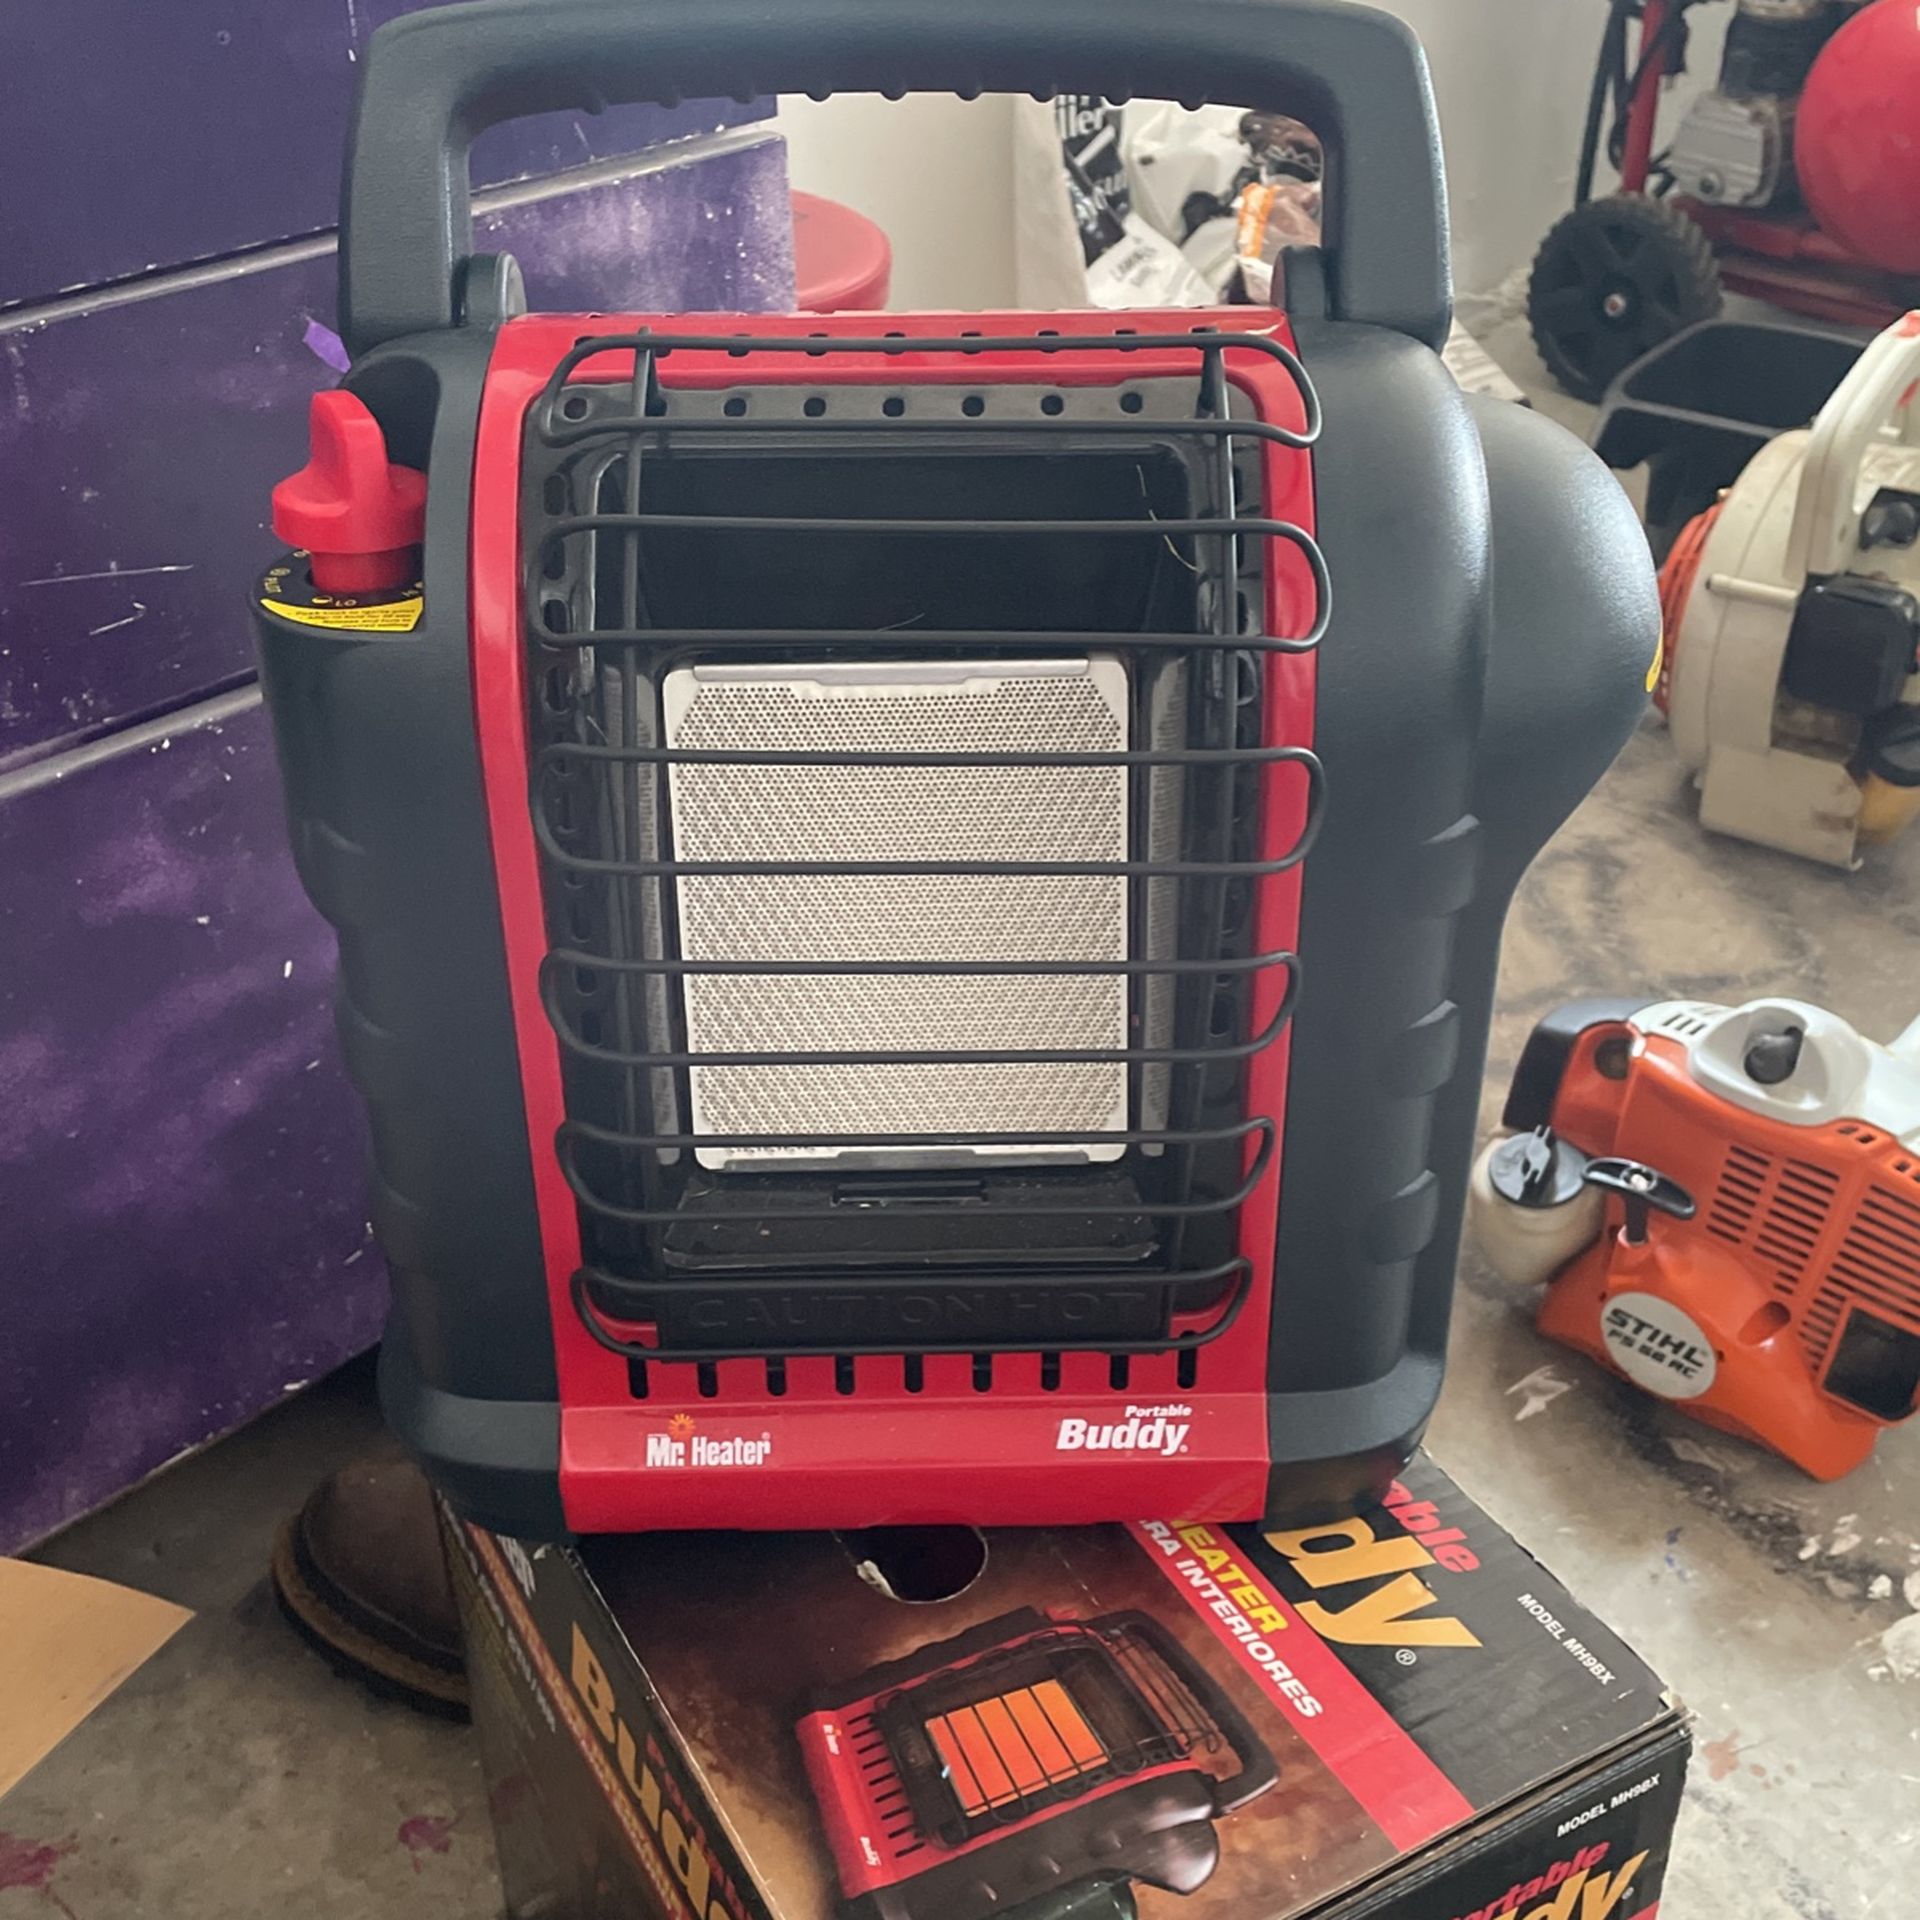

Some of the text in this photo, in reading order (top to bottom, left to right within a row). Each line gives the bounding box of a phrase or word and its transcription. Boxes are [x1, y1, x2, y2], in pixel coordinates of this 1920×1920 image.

[688, 1292, 1150, 1328] CAUTION HOT
[1606, 1308, 1704, 1368] STIHL
[1125, 1404, 1192, 1417] Portable
[646, 1435, 771, 1467] Mr. Heater
[1170, 1520, 1289, 1634] EATER
[1139, 1520, 1324, 1718] RA INTERIORES
[1517, 1593, 1616, 1685] MODEL MH9BX
[571, 1620, 731, 1920] Bud
[1557, 1773, 1661, 1838] MODEL MH9BX
